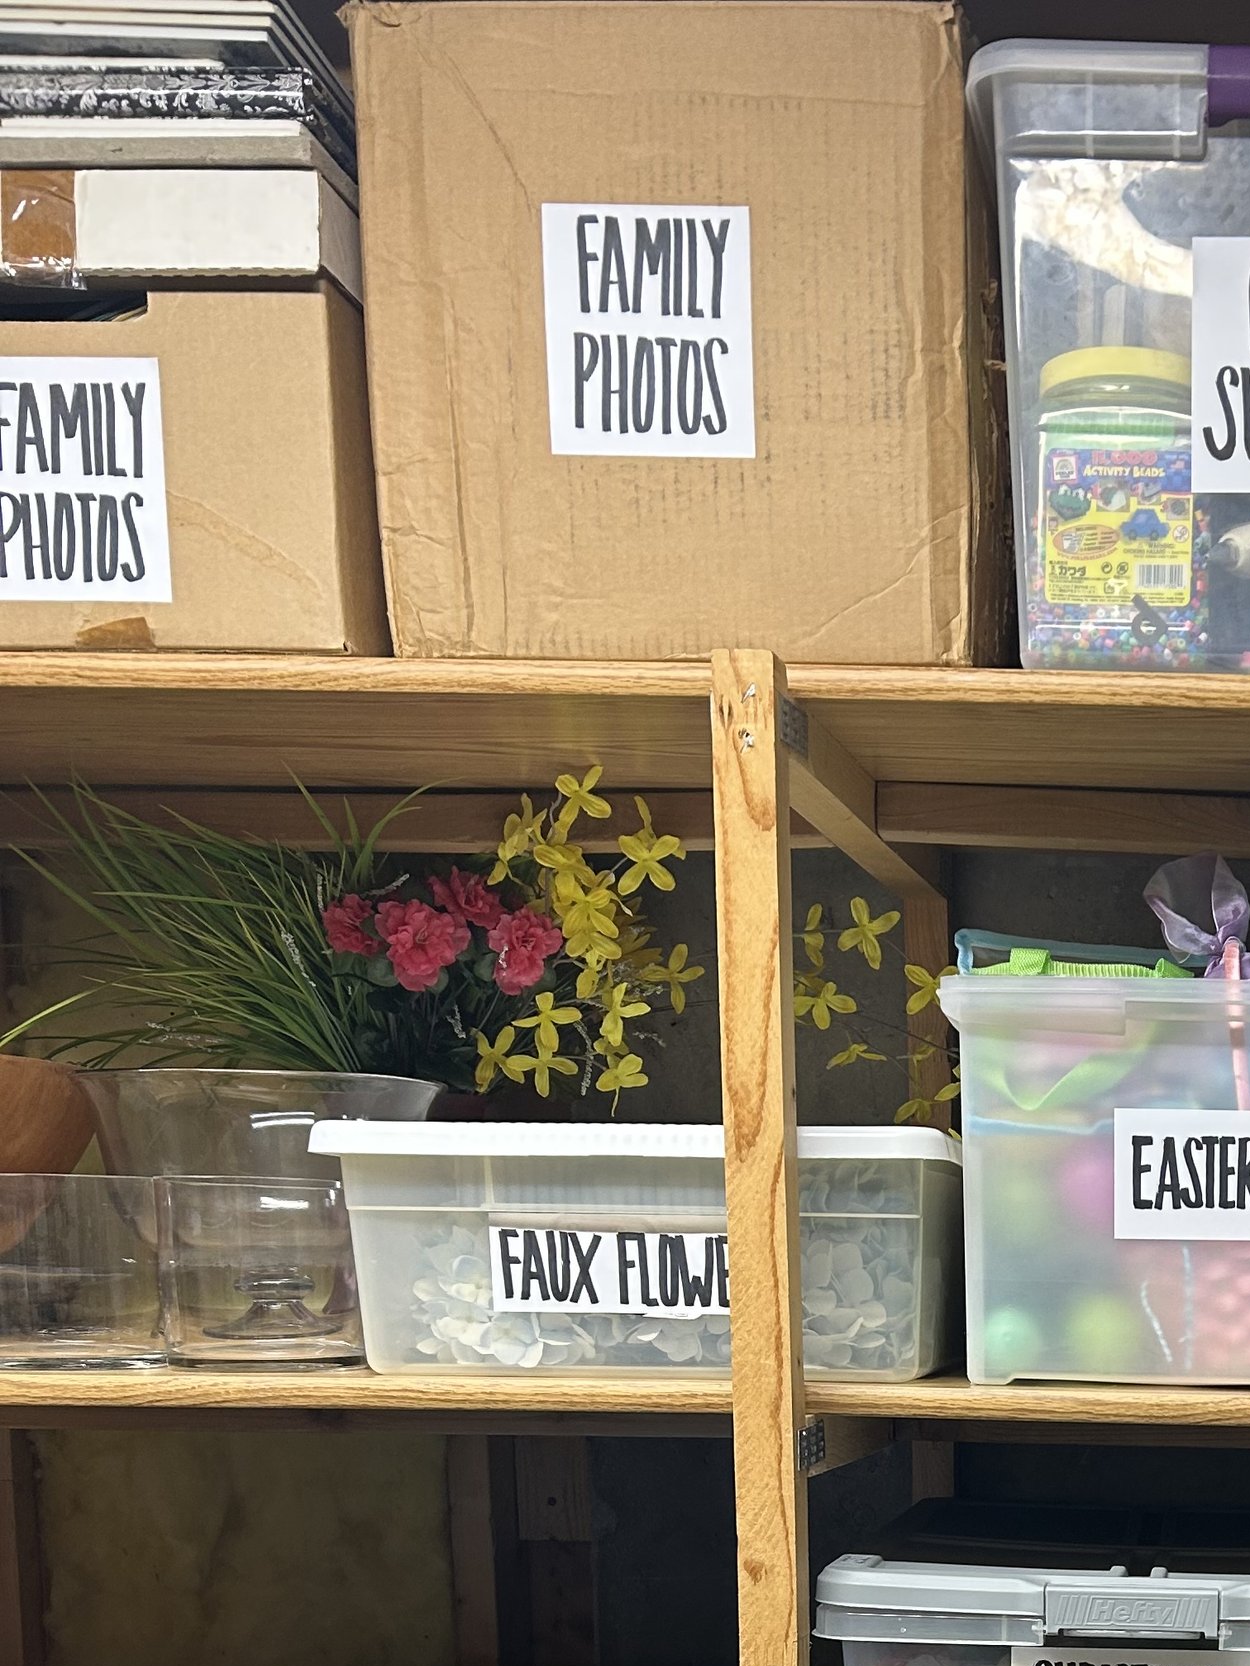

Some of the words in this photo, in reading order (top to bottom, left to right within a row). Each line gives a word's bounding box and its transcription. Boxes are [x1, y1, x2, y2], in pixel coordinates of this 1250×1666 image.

[577, 216, 730, 318] FAMILY
[574, 333, 728, 434] PHOTOS
[0, 382, 145, 478] FAMILY
[1083, 465, 1130, 477] ACTIVITY
[1133, 466, 1166, 478] BEADS
[0, 492, 145, 582] PHOTOS
[499, 1229, 601, 1304] FAUX
[1091, 1600, 1174, 1625] Hefty
